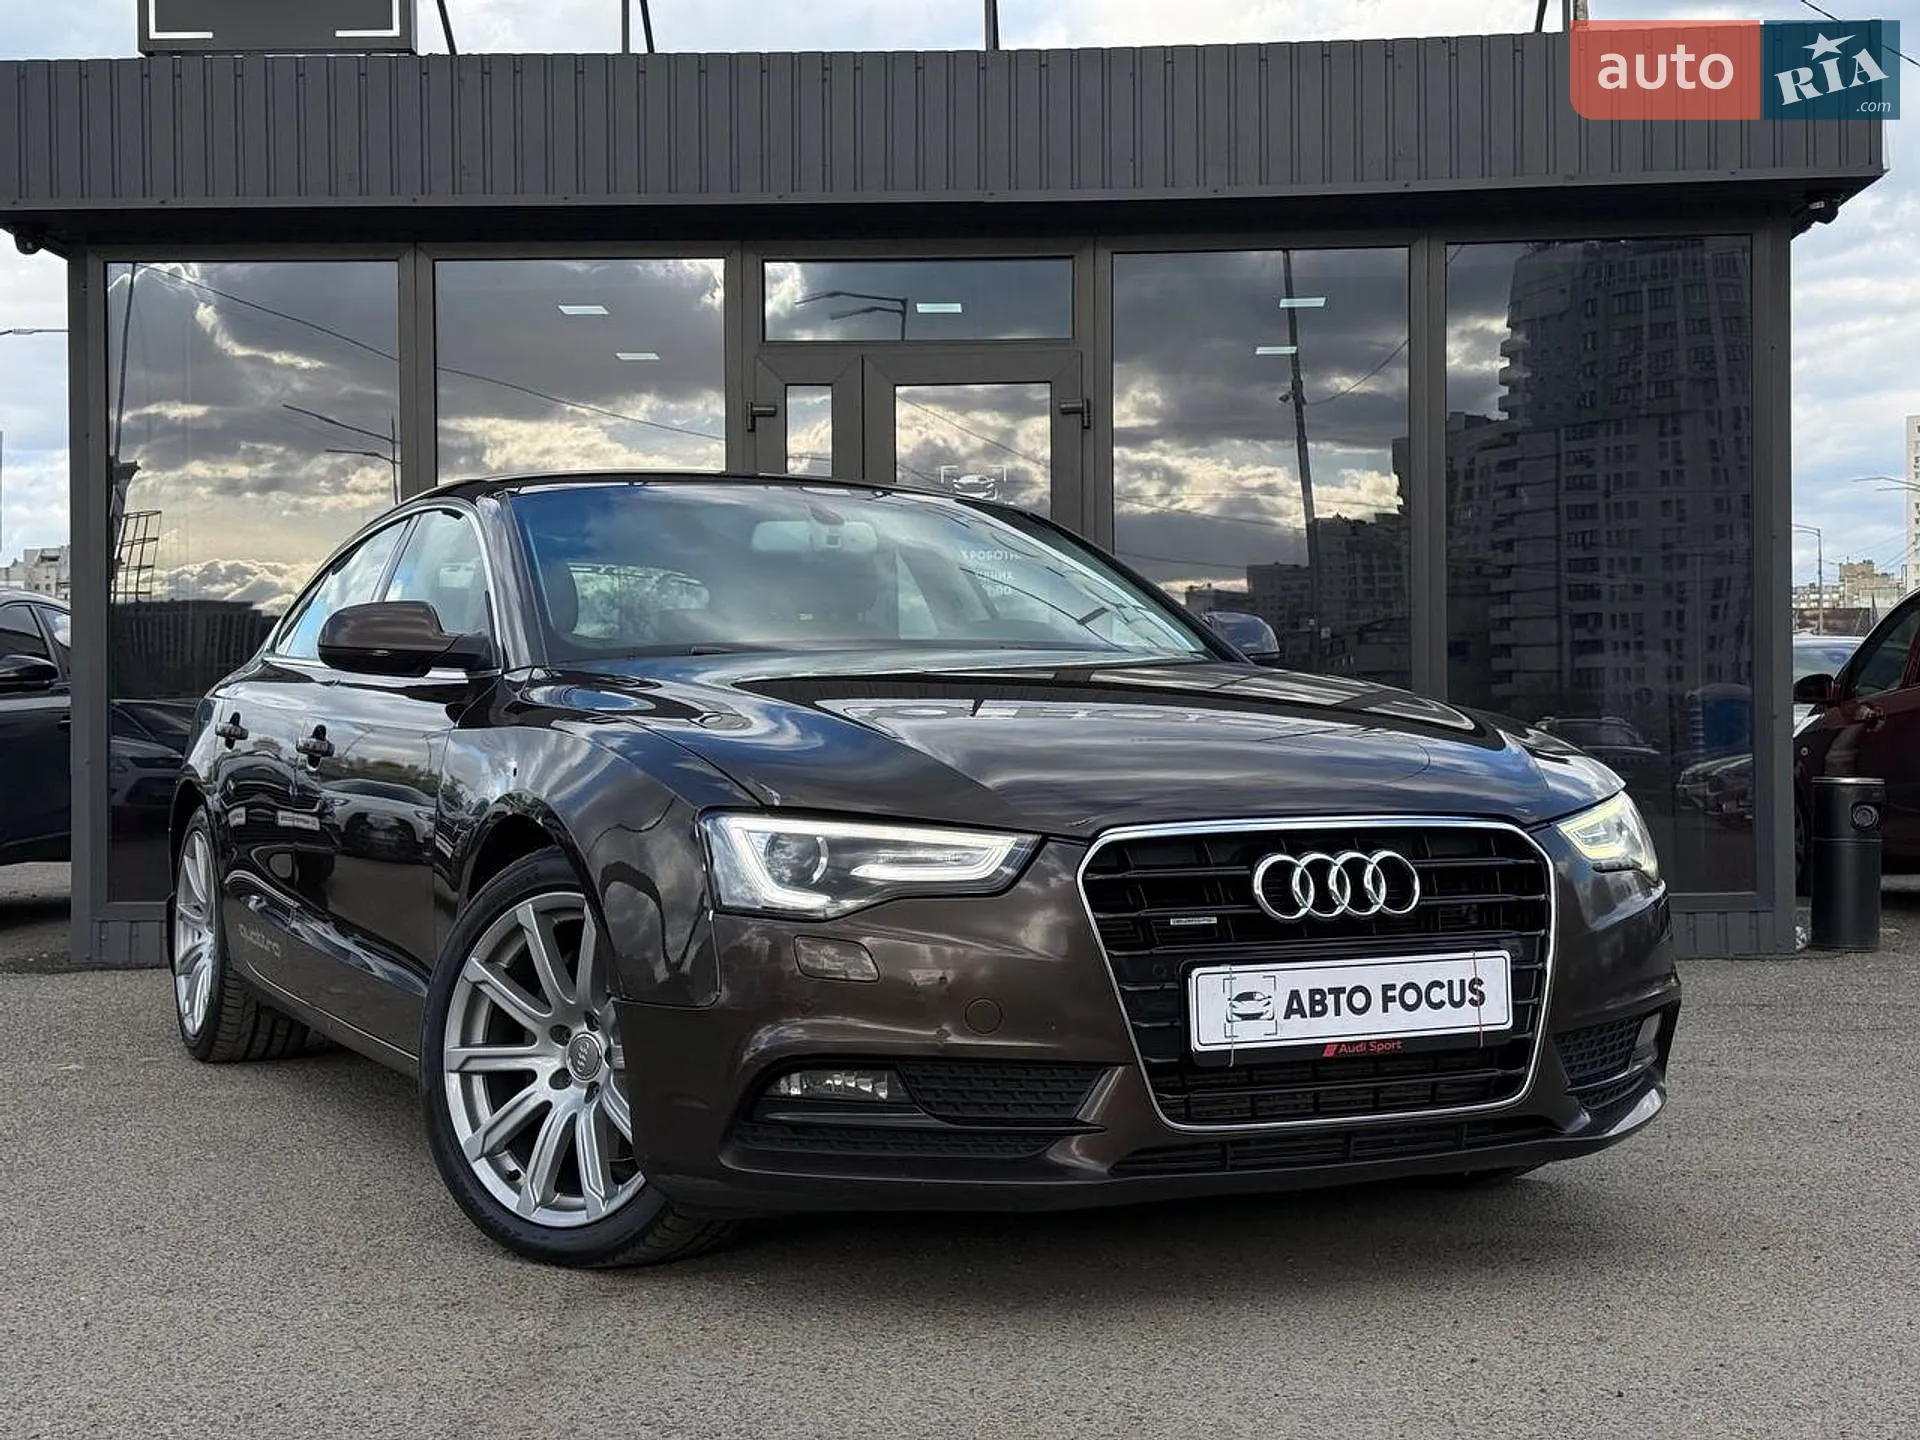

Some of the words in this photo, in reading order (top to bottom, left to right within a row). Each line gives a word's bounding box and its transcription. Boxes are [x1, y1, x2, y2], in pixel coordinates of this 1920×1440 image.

[1283, 985, 1372, 1019] АВТО
[1381, 977, 1486, 1013] FOCUS
[1338, 1042, 1366, 1054] Audi
[1368, 1040, 1403, 1053] Sport
